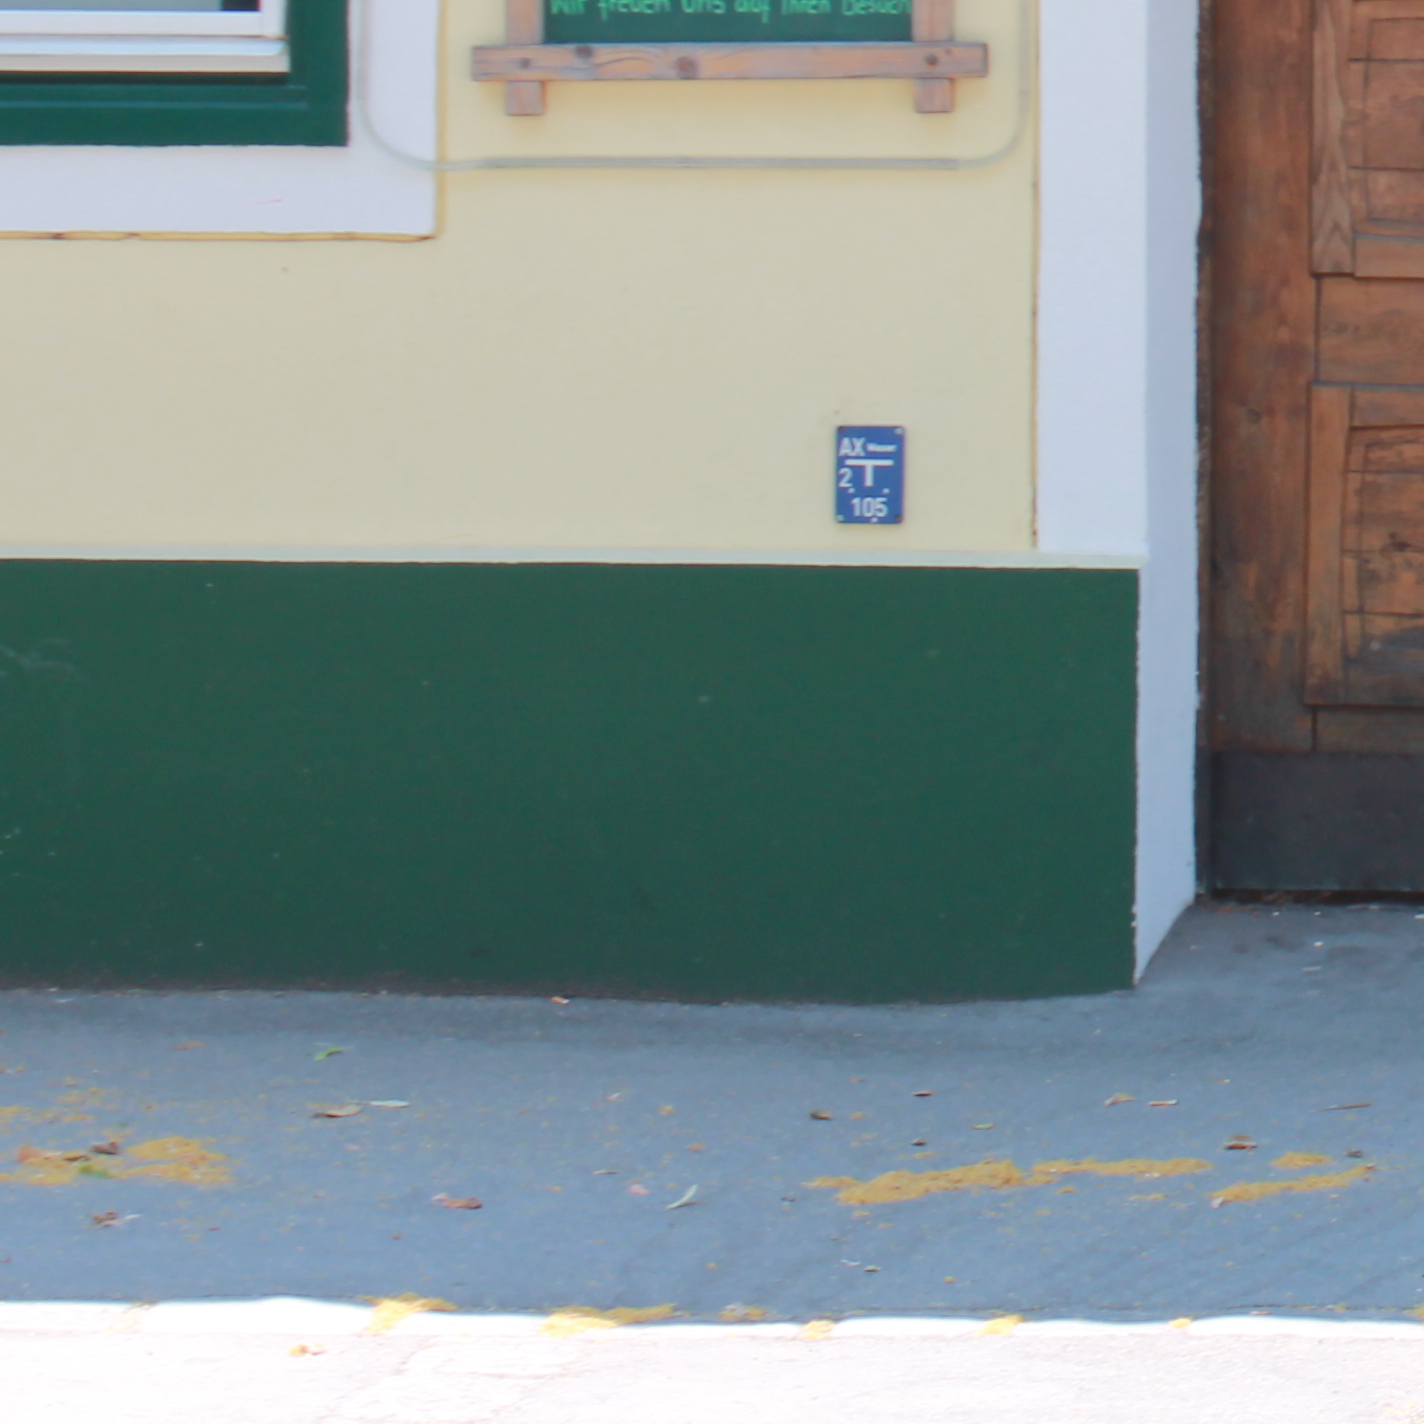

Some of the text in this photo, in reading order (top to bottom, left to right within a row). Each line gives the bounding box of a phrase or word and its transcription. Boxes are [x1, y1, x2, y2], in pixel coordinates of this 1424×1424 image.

[839, 437, 866, 457] AX
[838, 467, 853, 487] 2
[851, 496, 888, 517] 105
